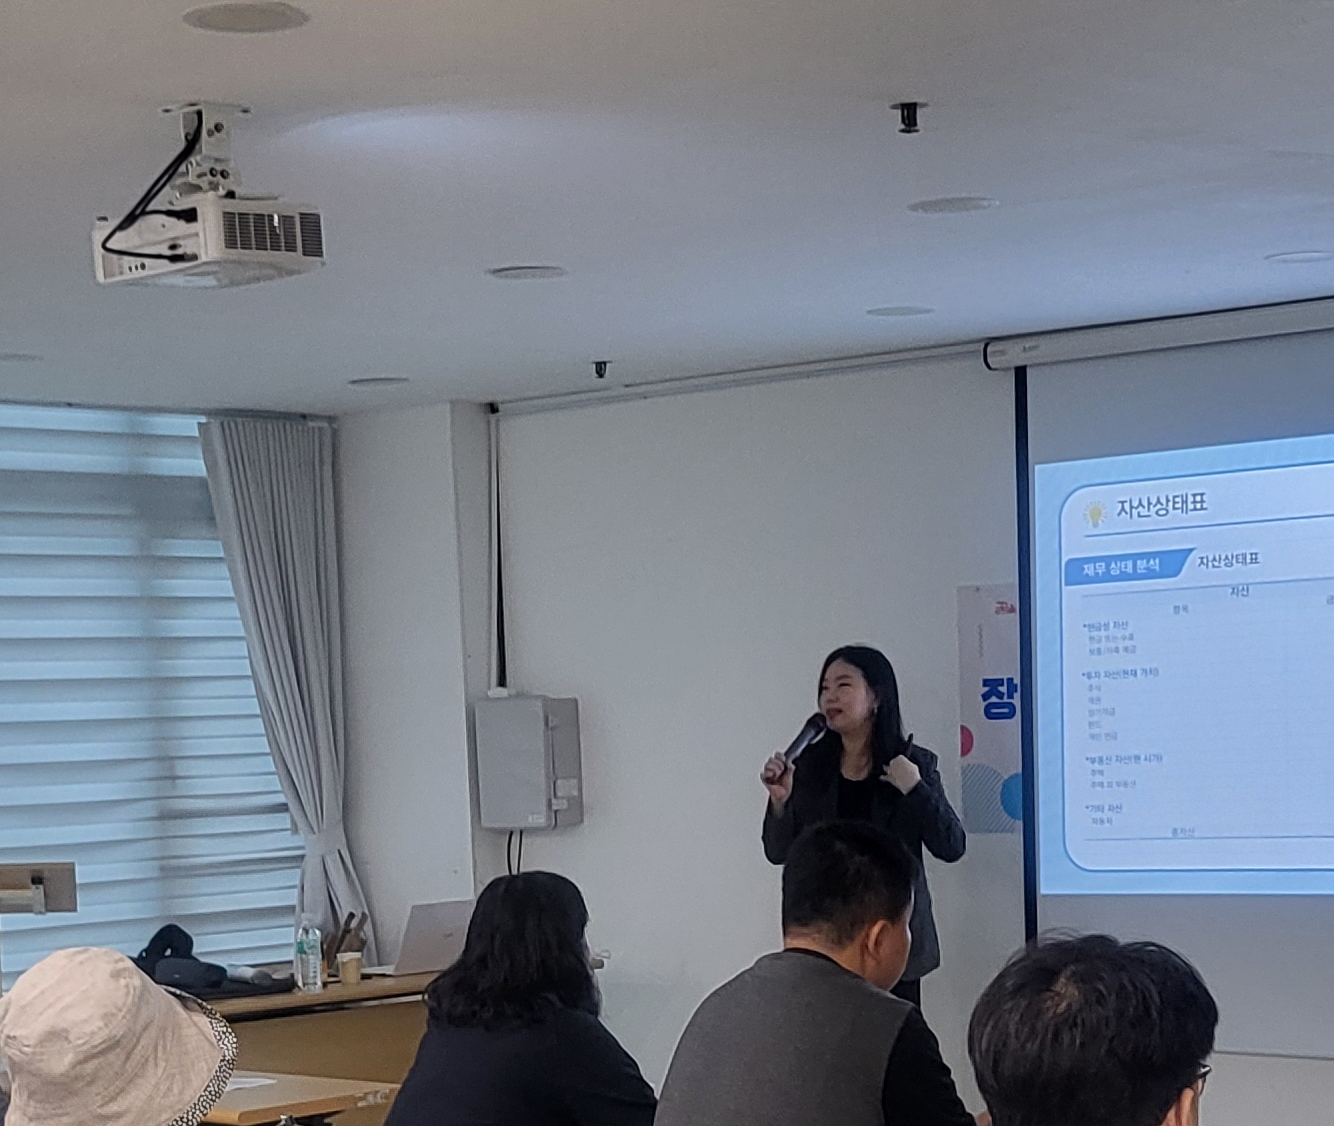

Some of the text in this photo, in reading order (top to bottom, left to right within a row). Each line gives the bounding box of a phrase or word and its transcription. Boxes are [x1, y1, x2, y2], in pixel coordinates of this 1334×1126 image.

[1117, 491, 1208, 520] 자산상태표
[1082, 559, 1160, 577] 재무 상태 분석
[1197, 552, 1260, 569] 자산상태표
[1230, 586, 1250, 597] 자산
[981, 677, 1018, 720] 장
